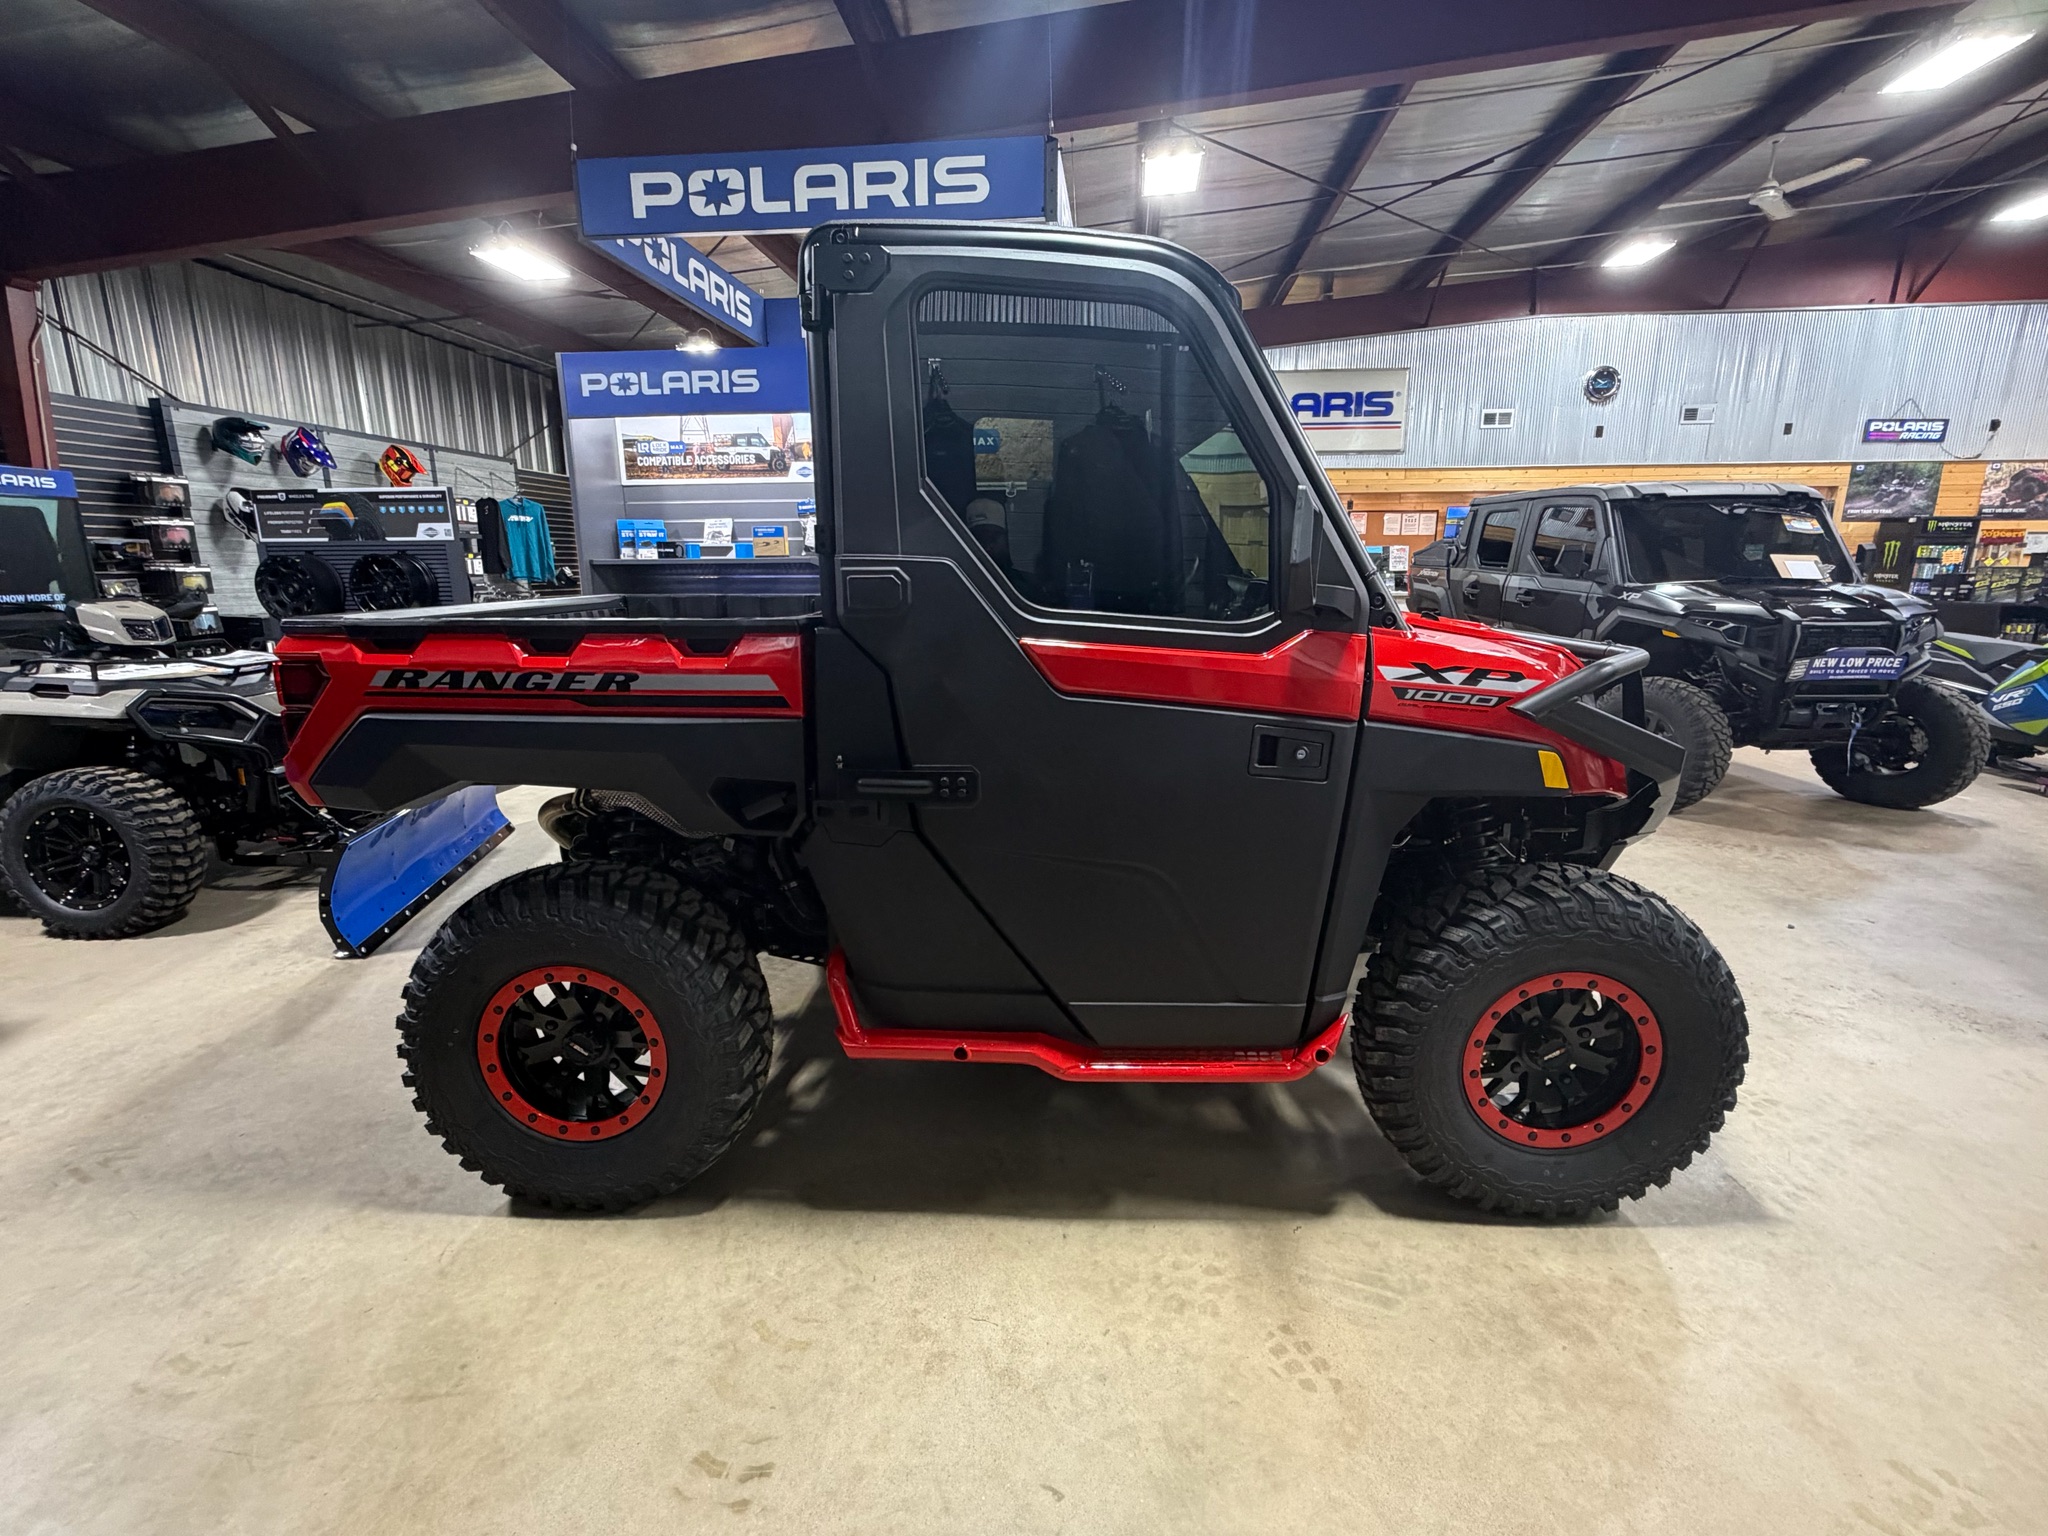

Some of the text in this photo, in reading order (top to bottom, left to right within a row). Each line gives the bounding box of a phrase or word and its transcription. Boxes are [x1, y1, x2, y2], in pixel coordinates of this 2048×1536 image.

[630, 155, 990, 219] POLARIS
[581, 369, 761, 397] POLARIS
[1870, 422, 1945, 431] POLARIS
[1899, 432, 1943, 440] RACING
[637, 454, 756, 467] COMPATIBLE ACCESSORIES
[0, 473, 57, 489] ARIS
[26, 593, 53, 602] MORE
[53, 593, 66, 602] OF
[1618, 591, 1642, 601] XP
[1813, 658, 1903, 668] NEW LOW PRICE
[1393, 661, 1529, 687] XP
[385, 669, 640, 693] RANGER
[1404, 689, 1499, 707] 1000
[1992, 698, 2024, 711] 650
